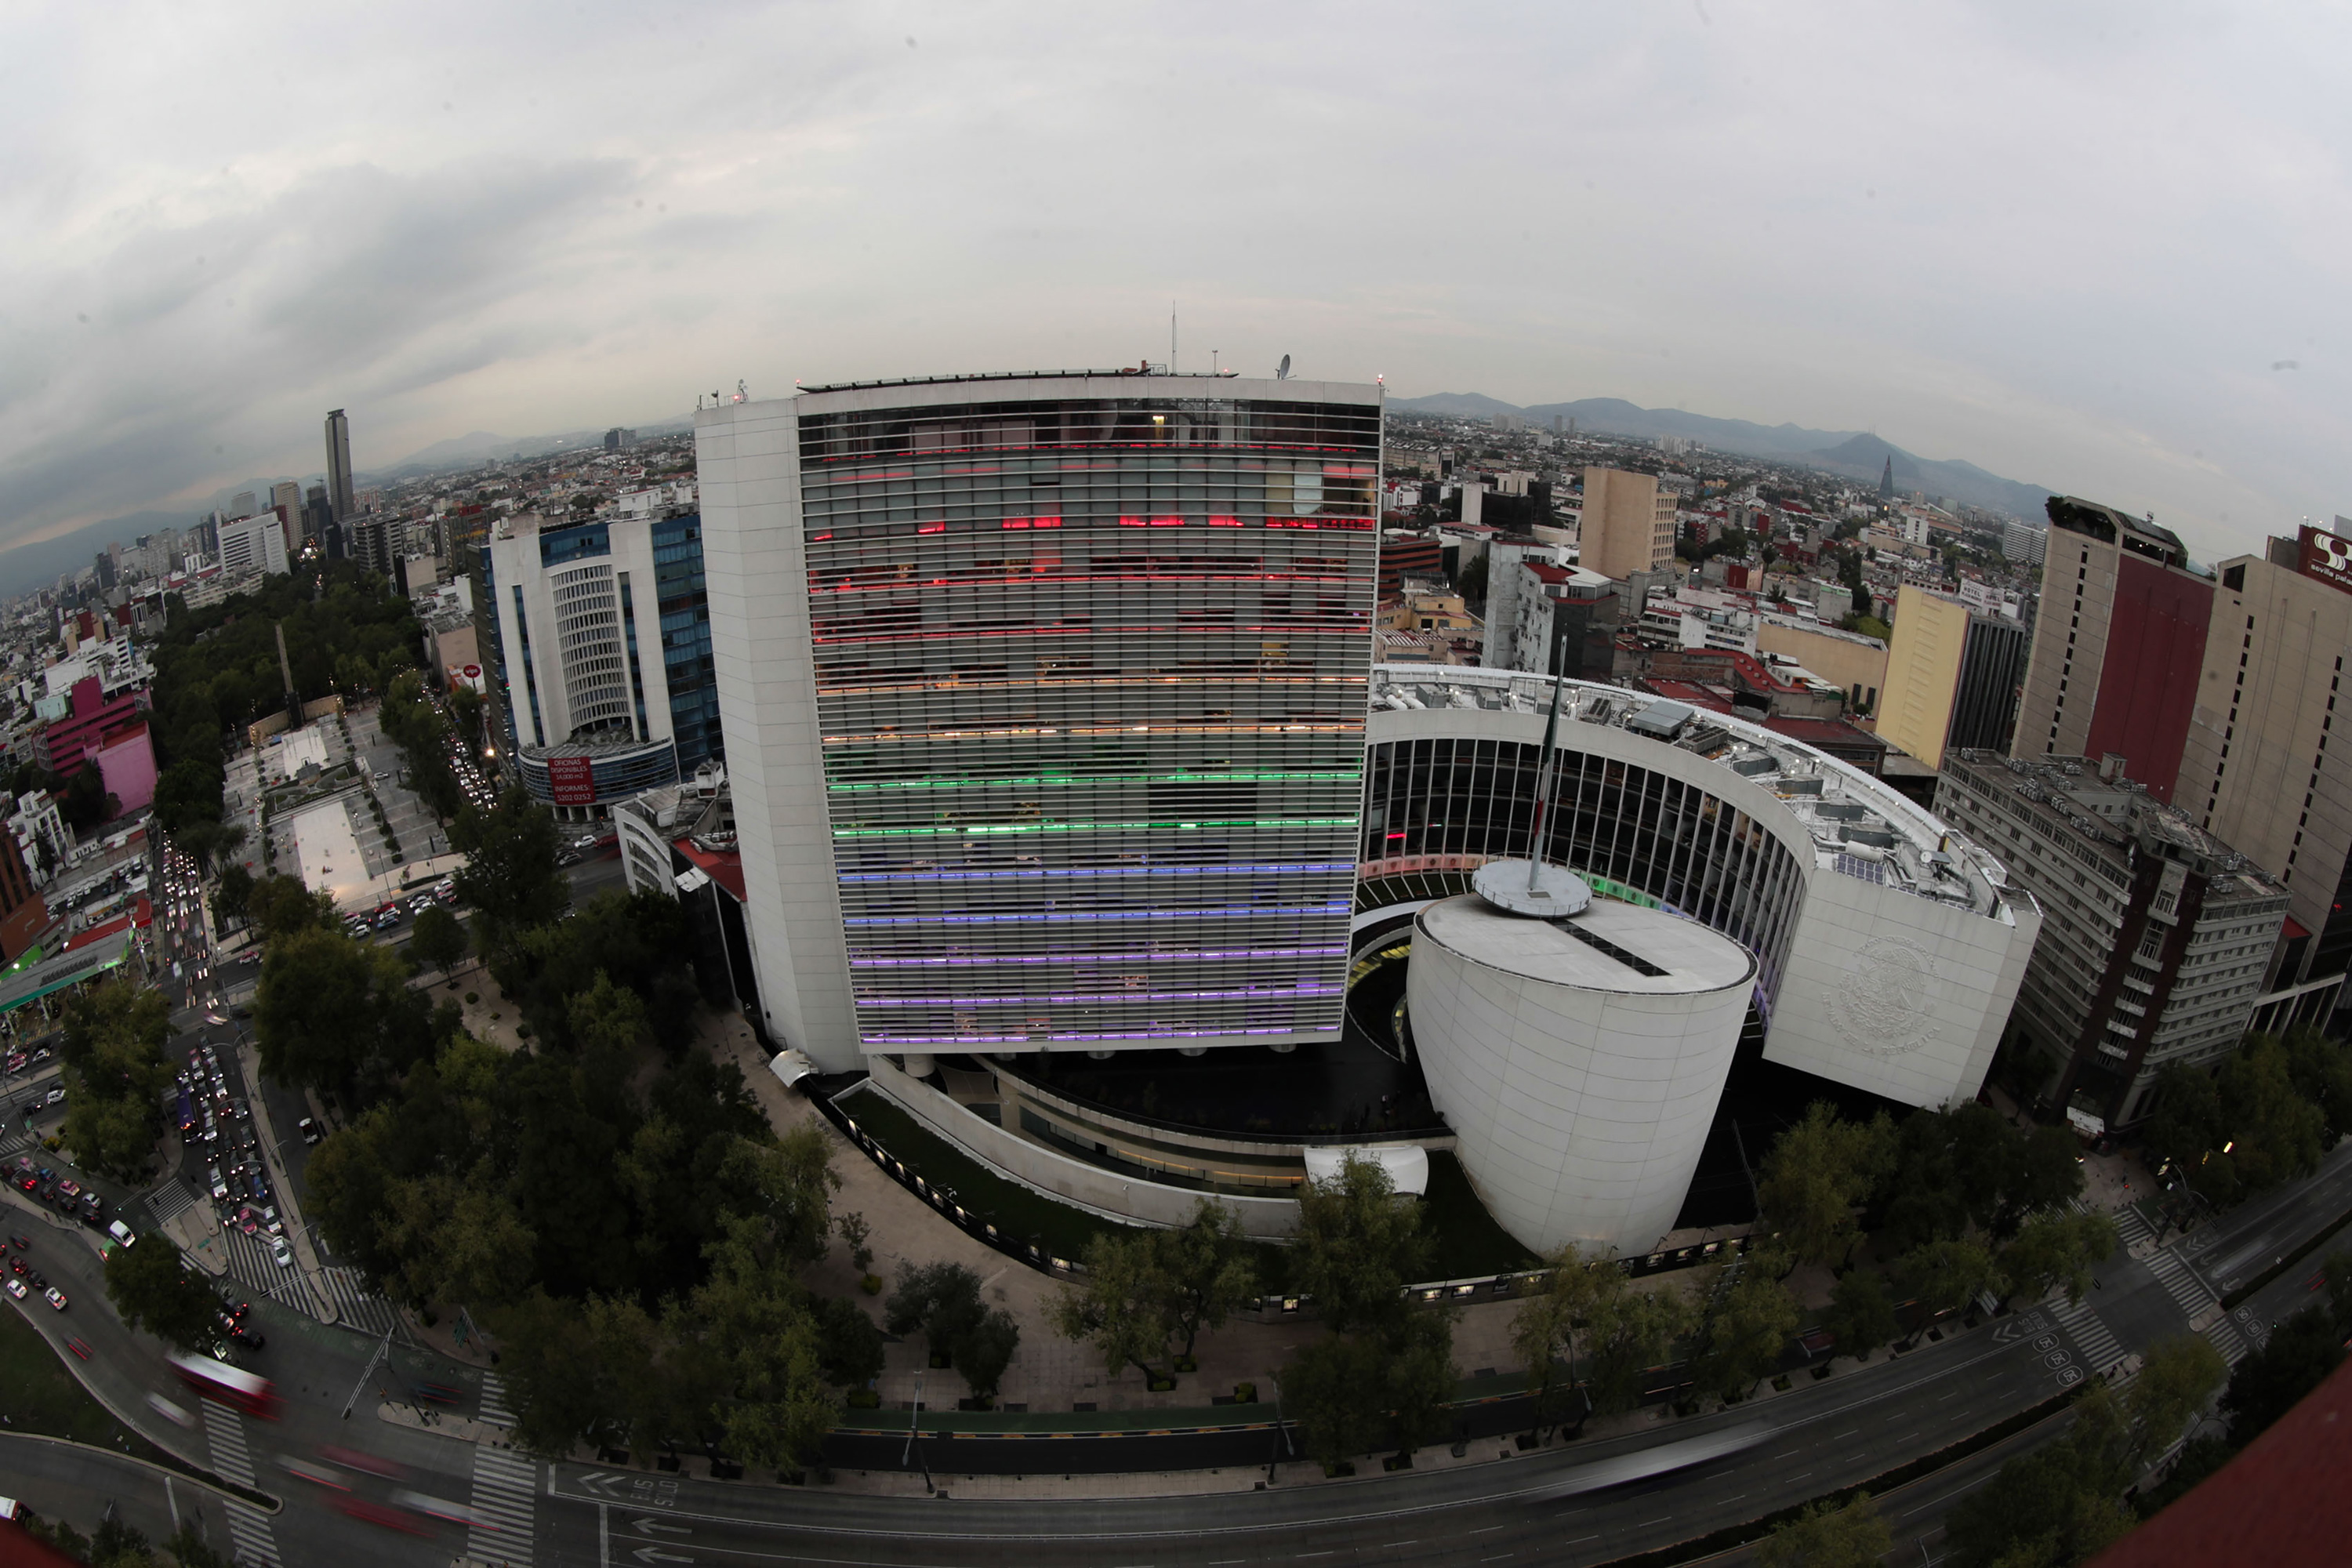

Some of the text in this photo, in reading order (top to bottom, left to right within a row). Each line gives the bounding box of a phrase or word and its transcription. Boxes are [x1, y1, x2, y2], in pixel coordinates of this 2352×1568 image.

[2310, 564, 2334, 578] sevilla
[1964, 586, 1980, 597] HOTEL
[550, 765, 588, 774] DISPONIBLES
[554, 784, 590, 793] INFORMES:
[2050, 1352, 2067, 1366] 50
[2063, 1369, 2079, 1383] 50
[630, 1479, 654, 1501] BUS
[654, 1479, 679, 1507] SOLO
